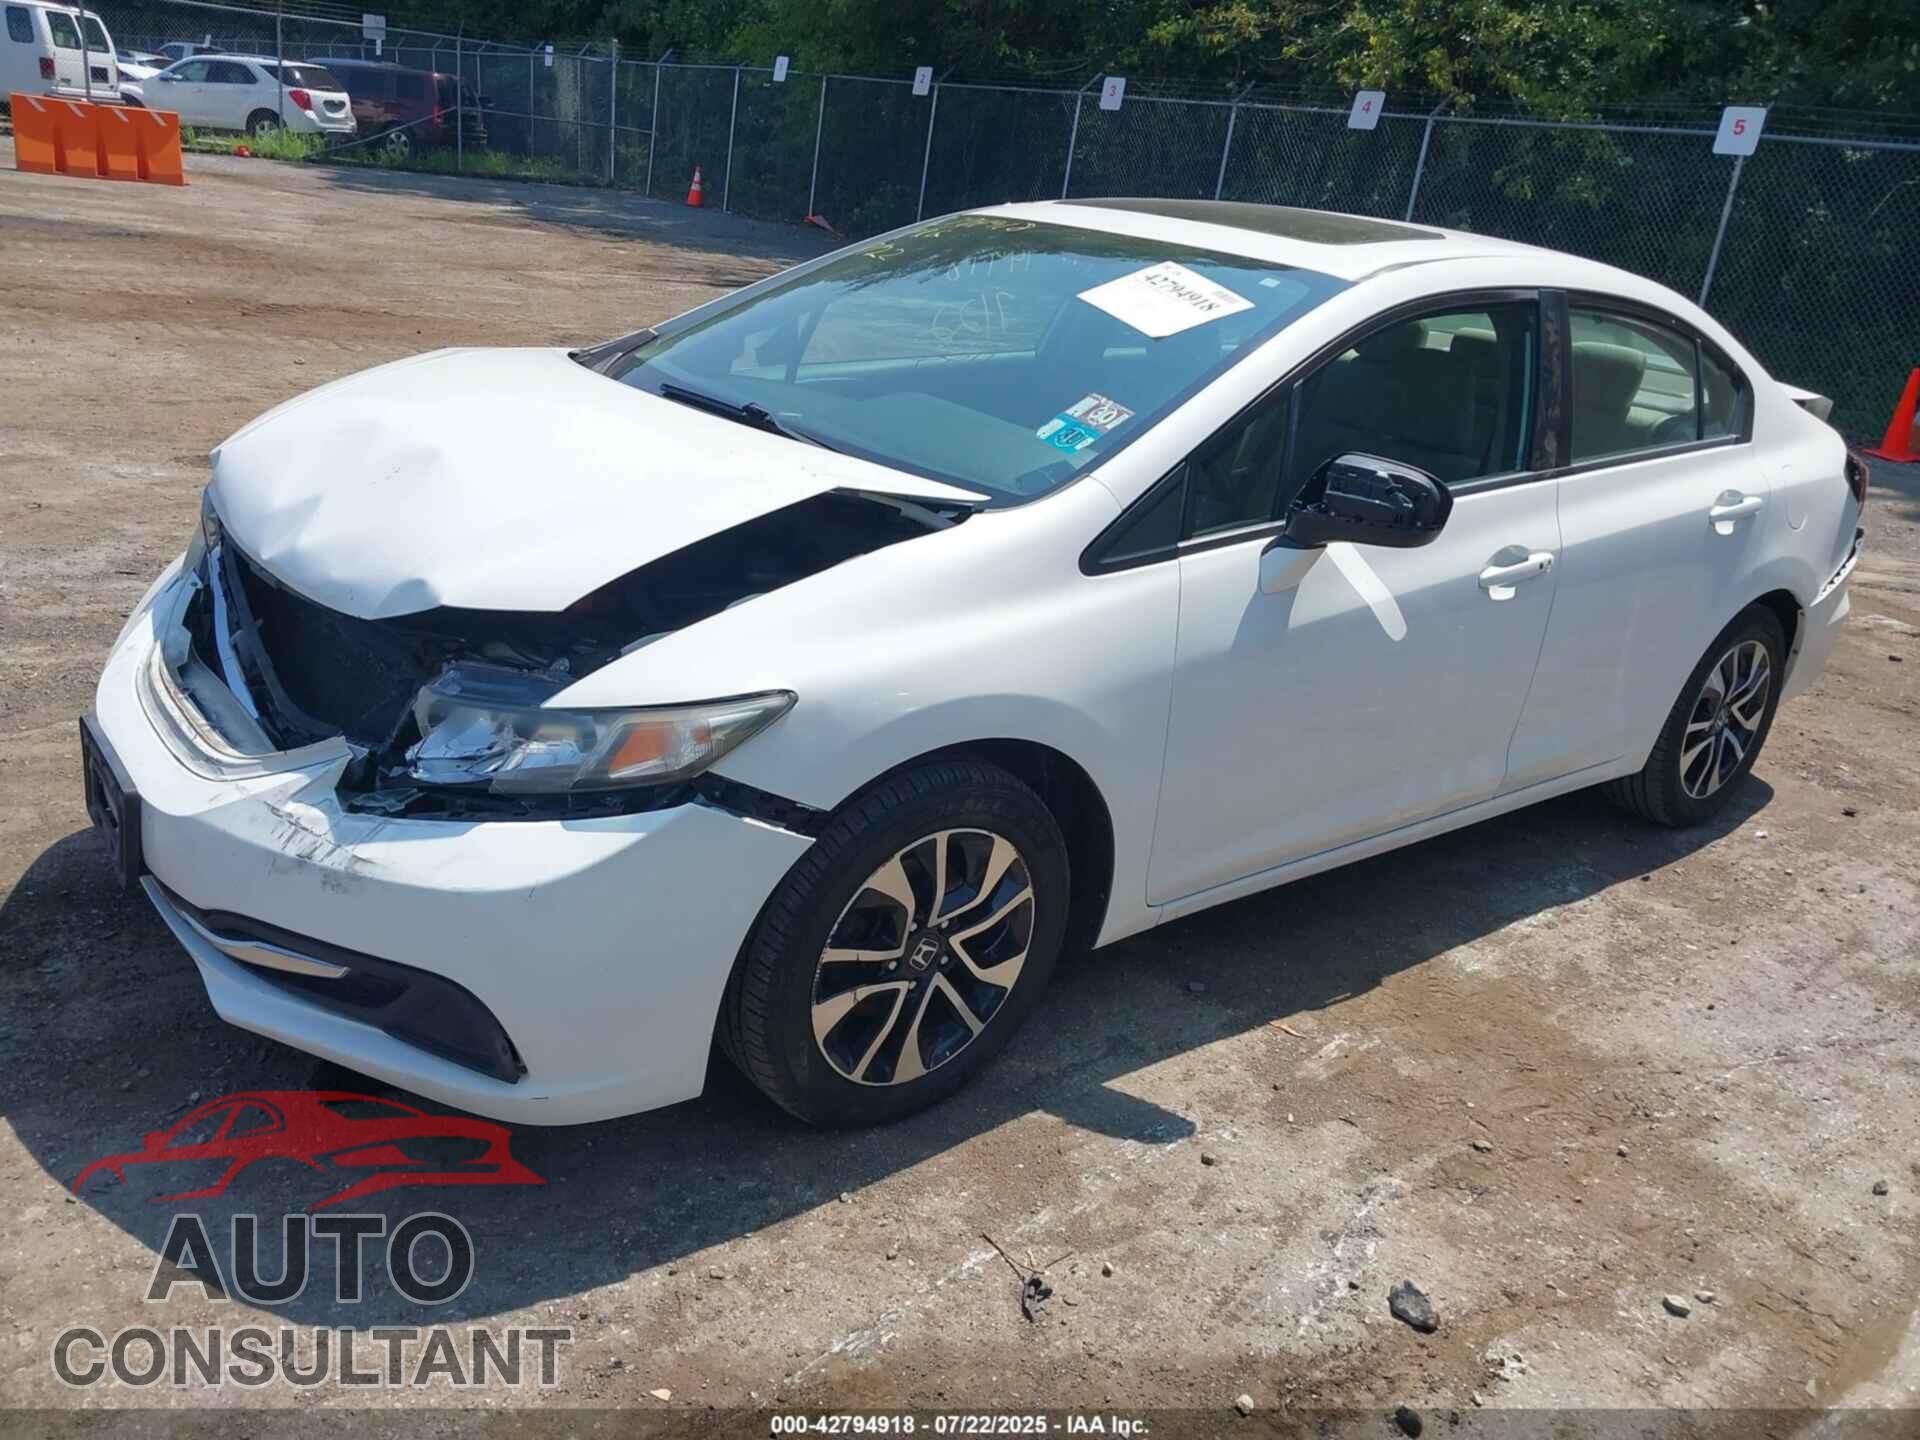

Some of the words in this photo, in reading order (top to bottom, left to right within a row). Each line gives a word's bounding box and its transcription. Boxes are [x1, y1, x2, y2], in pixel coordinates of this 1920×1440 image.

[1108, 85, 1117, 97] 3
[1361, 100, 1372, 114] 4
[1733, 119, 1746, 135] 5
